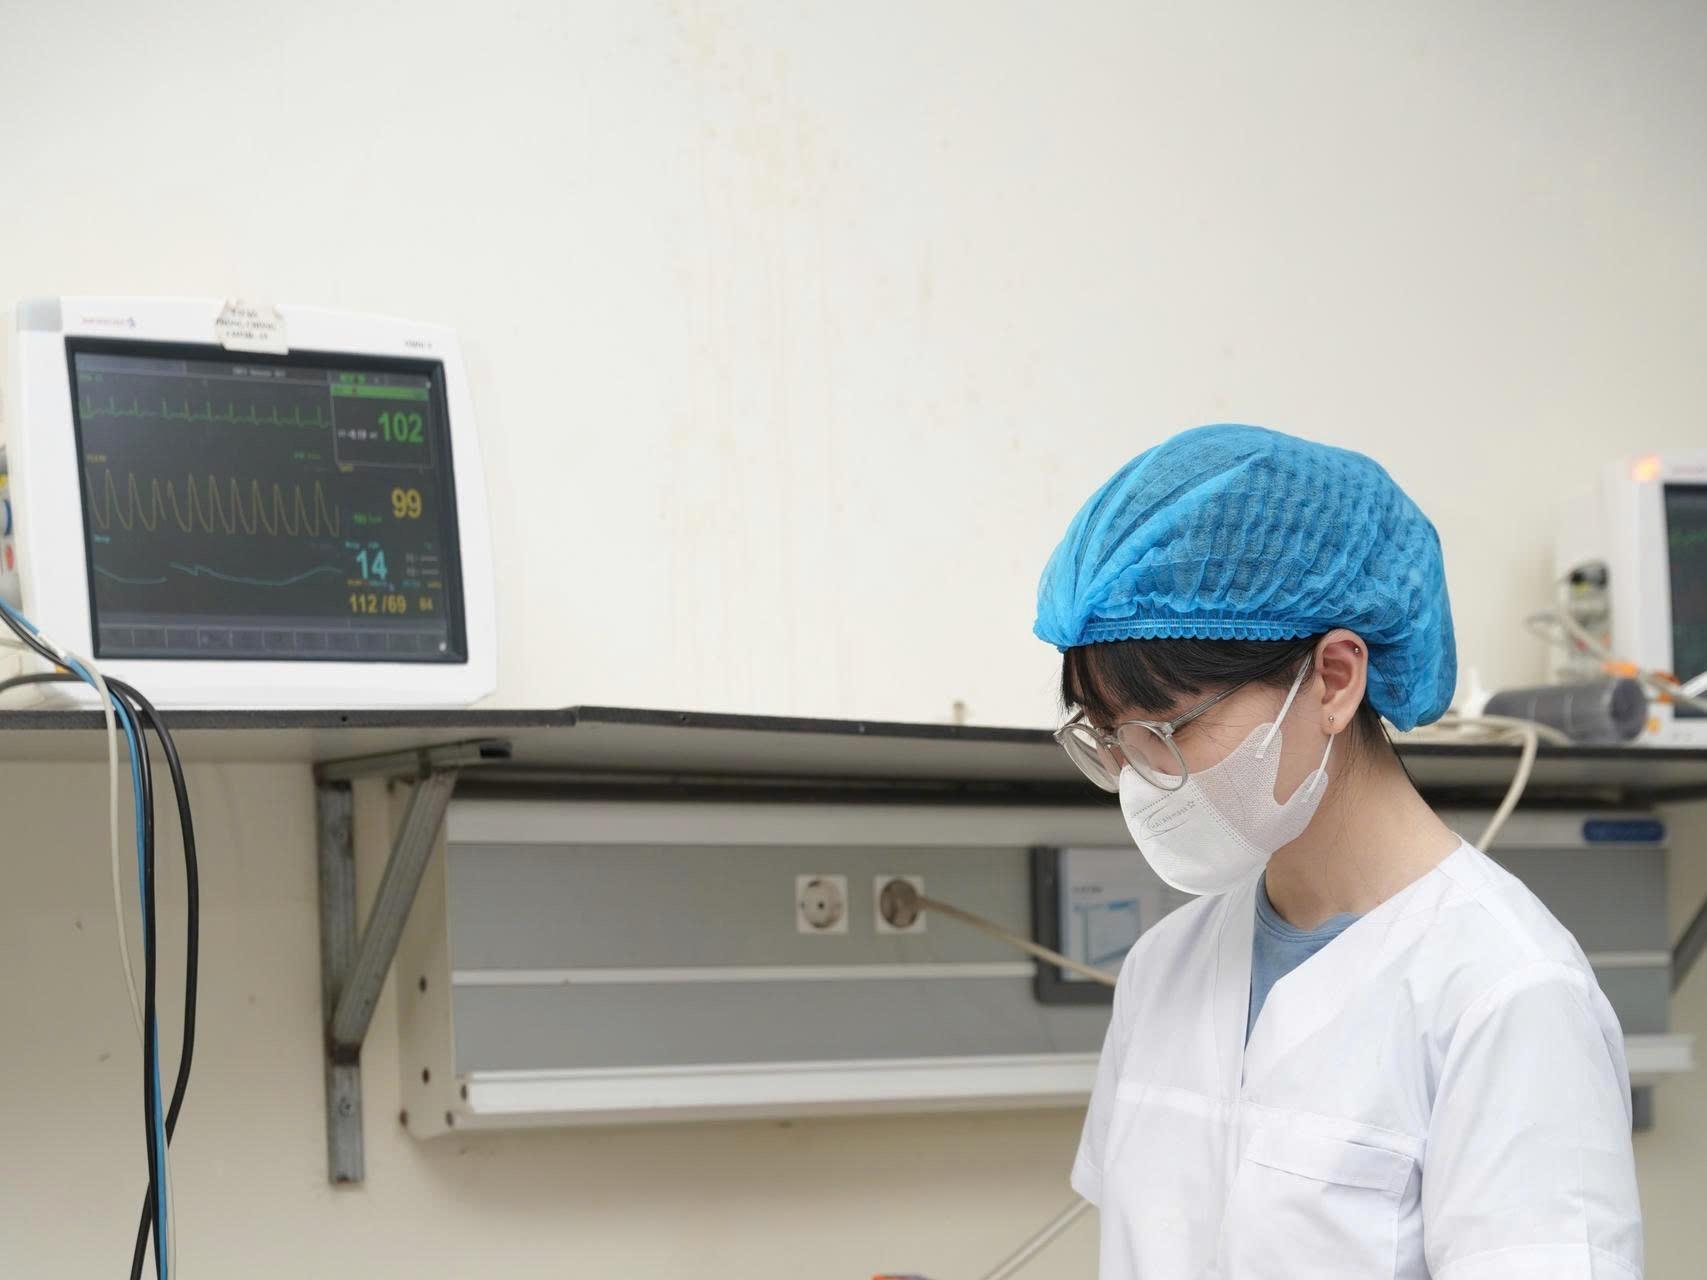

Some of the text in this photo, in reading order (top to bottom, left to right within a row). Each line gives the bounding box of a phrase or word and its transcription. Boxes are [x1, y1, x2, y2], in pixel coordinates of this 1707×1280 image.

[378, 411, 424, 442] 102
[391, 488, 422, 518] 99
[356, 550, 388, 580] 14
